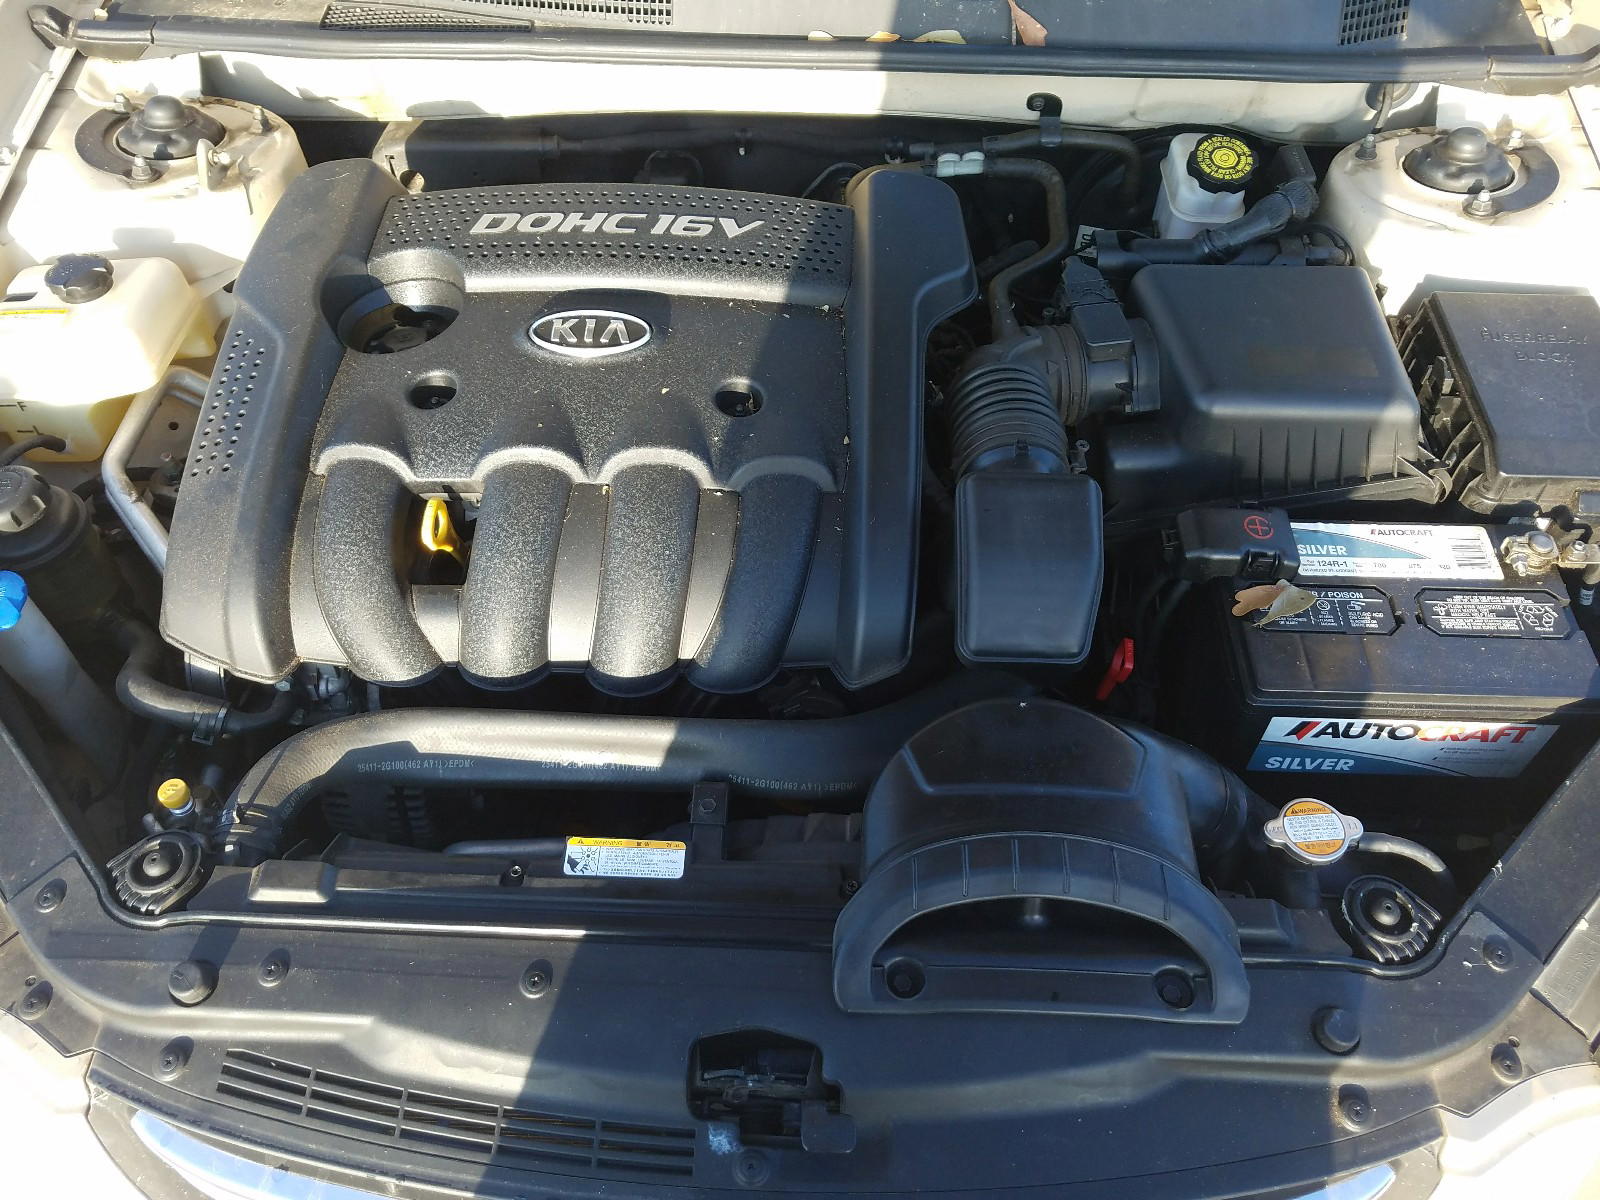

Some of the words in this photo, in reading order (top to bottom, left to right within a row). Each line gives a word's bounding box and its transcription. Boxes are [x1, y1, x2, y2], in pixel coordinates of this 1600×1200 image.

[469, 212, 648, 234] DOHC
[650, 214, 765, 239] 16V
[550, 318, 630, 344] KIA
[1377, 528, 1434, 537] AUTOCRAFT
[1296, 543, 1348, 556] SILVER
[1316, 560, 1348, 568] 124R-1
[1328, 591, 1364, 599] POISON
[1311, 721, 1537, 743] AUTOCRAFT
[1265, 757, 1355, 771] SILVER
